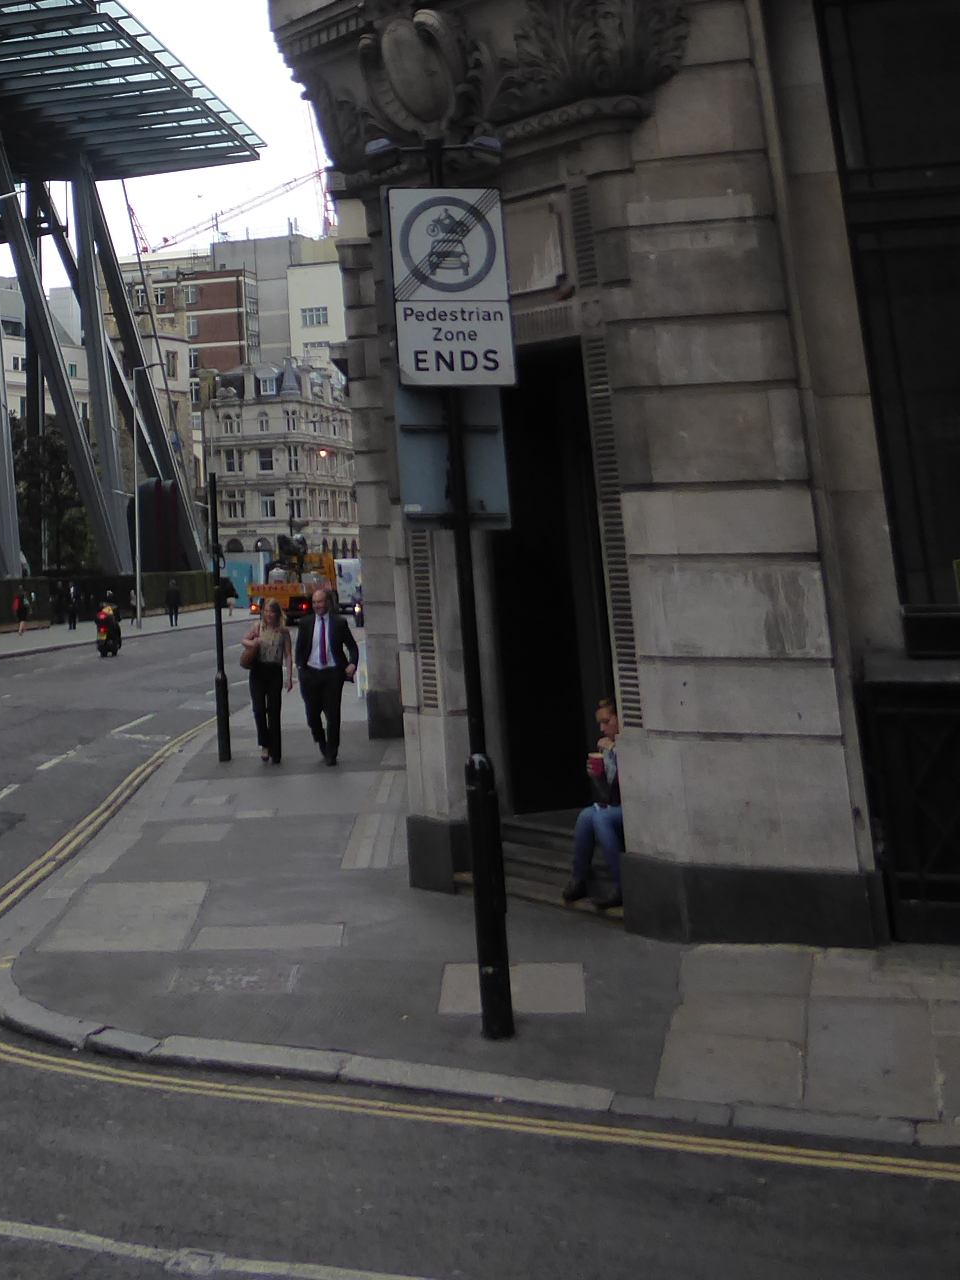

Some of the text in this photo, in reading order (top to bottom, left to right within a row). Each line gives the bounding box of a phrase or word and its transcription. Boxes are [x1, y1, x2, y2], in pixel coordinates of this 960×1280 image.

[402, 306, 504, 322] Pedestrian
[432, 326, 478, 342] Zone
[413, 348, 500, 372] ENDS
